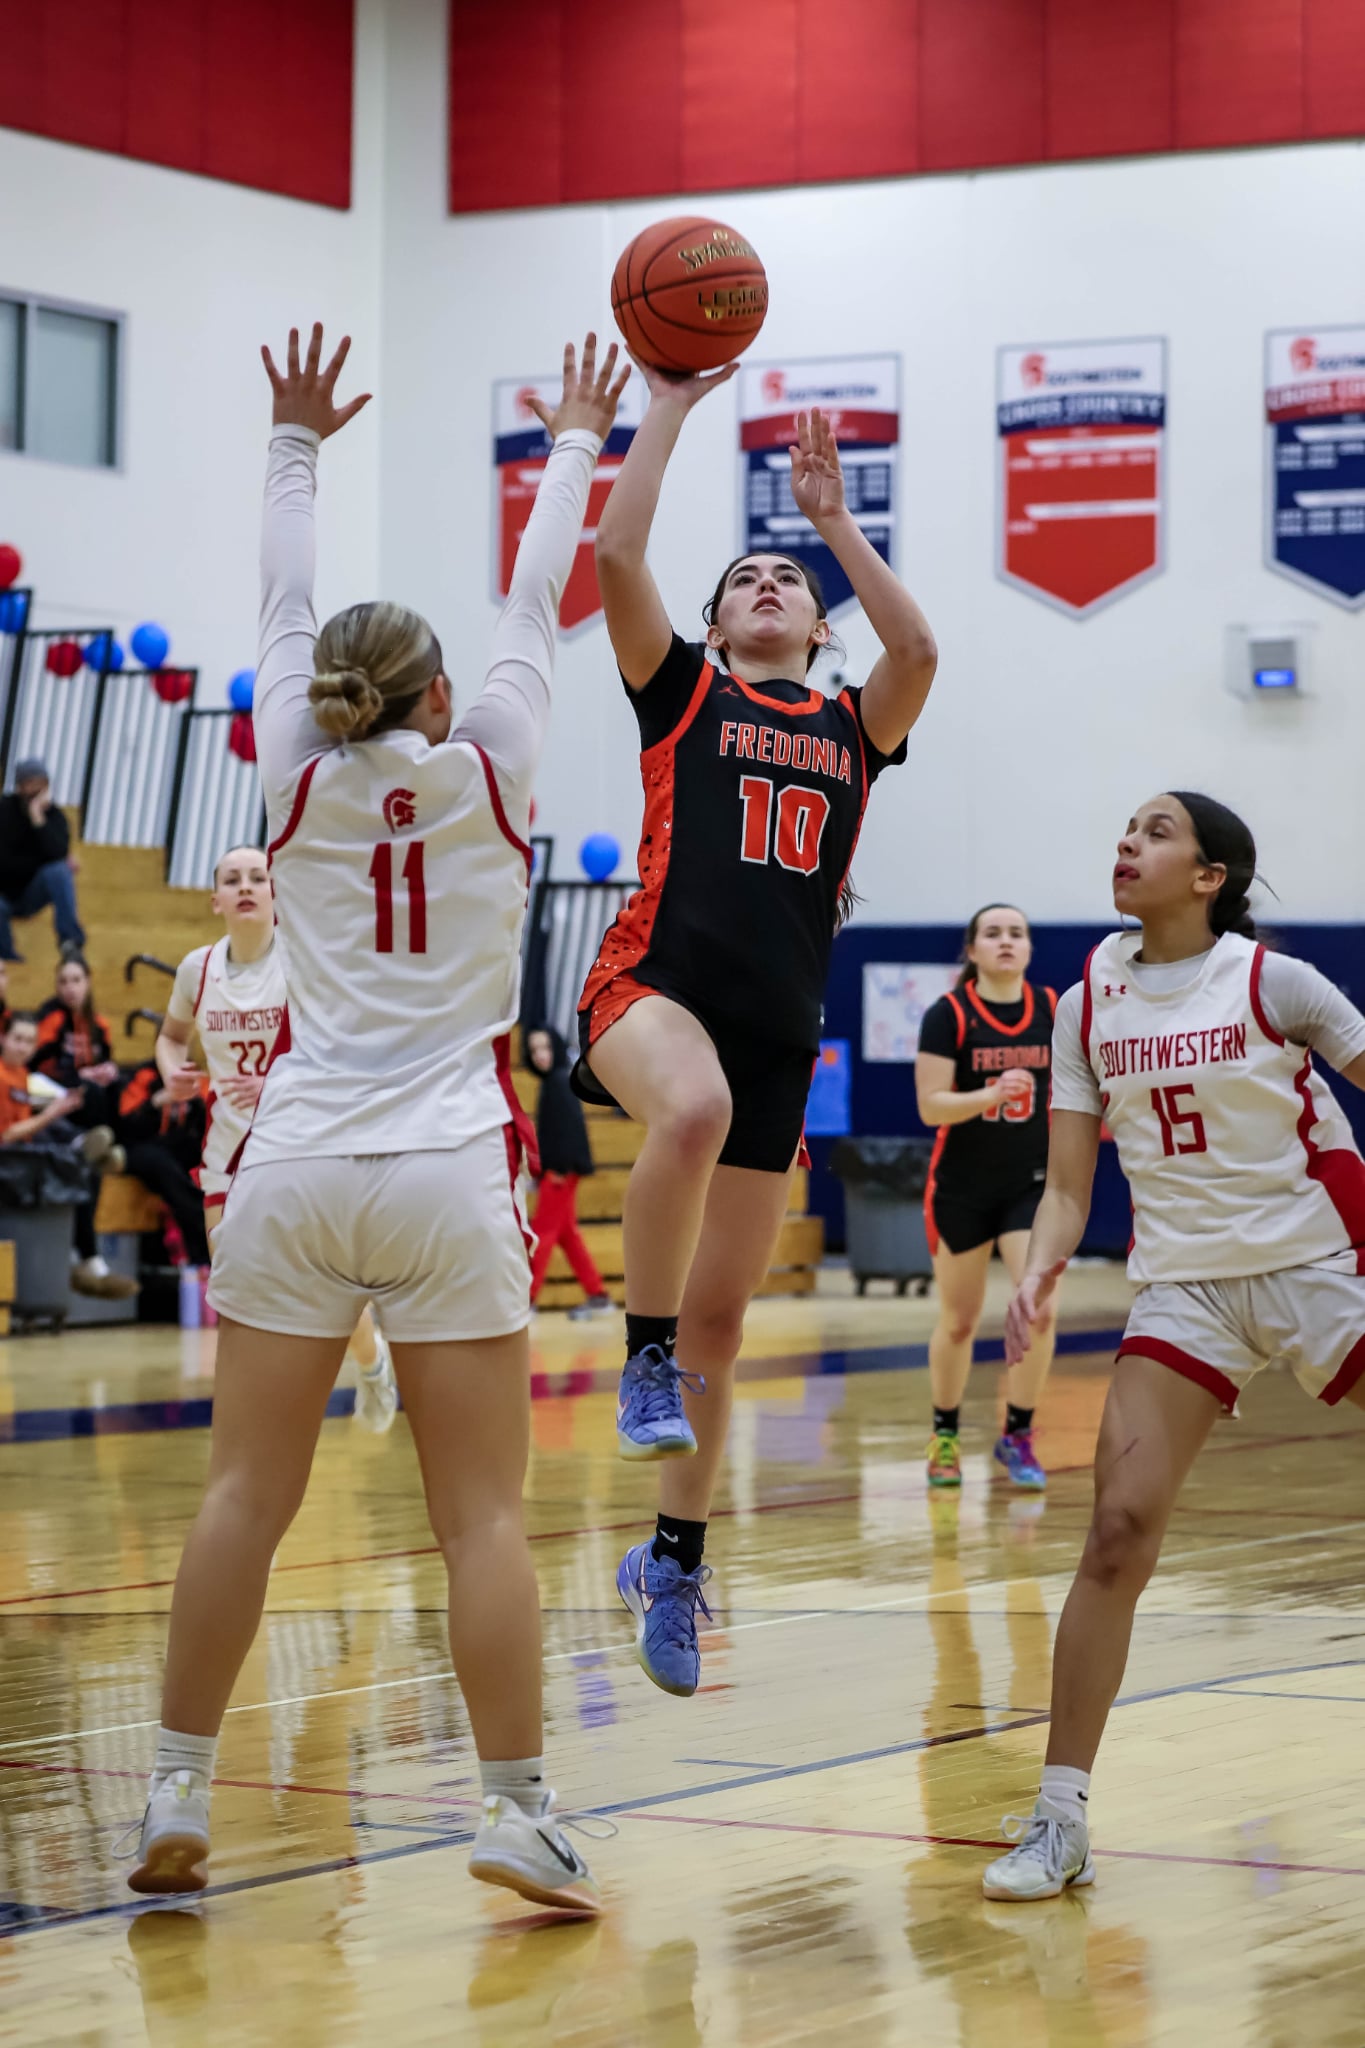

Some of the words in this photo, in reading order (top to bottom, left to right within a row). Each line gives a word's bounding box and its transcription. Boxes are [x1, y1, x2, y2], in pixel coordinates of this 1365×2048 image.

[719, 720, 851, 785] FREDONIA
[739, 774, 830, 877] 10
[368, 841, 427, 953] 11
[229, 1040, 267, 1076] 22
[1099, 1023, 1246, 1079] SOUTHWESTERN
[1150, 1083, 1207, 1156] 15
